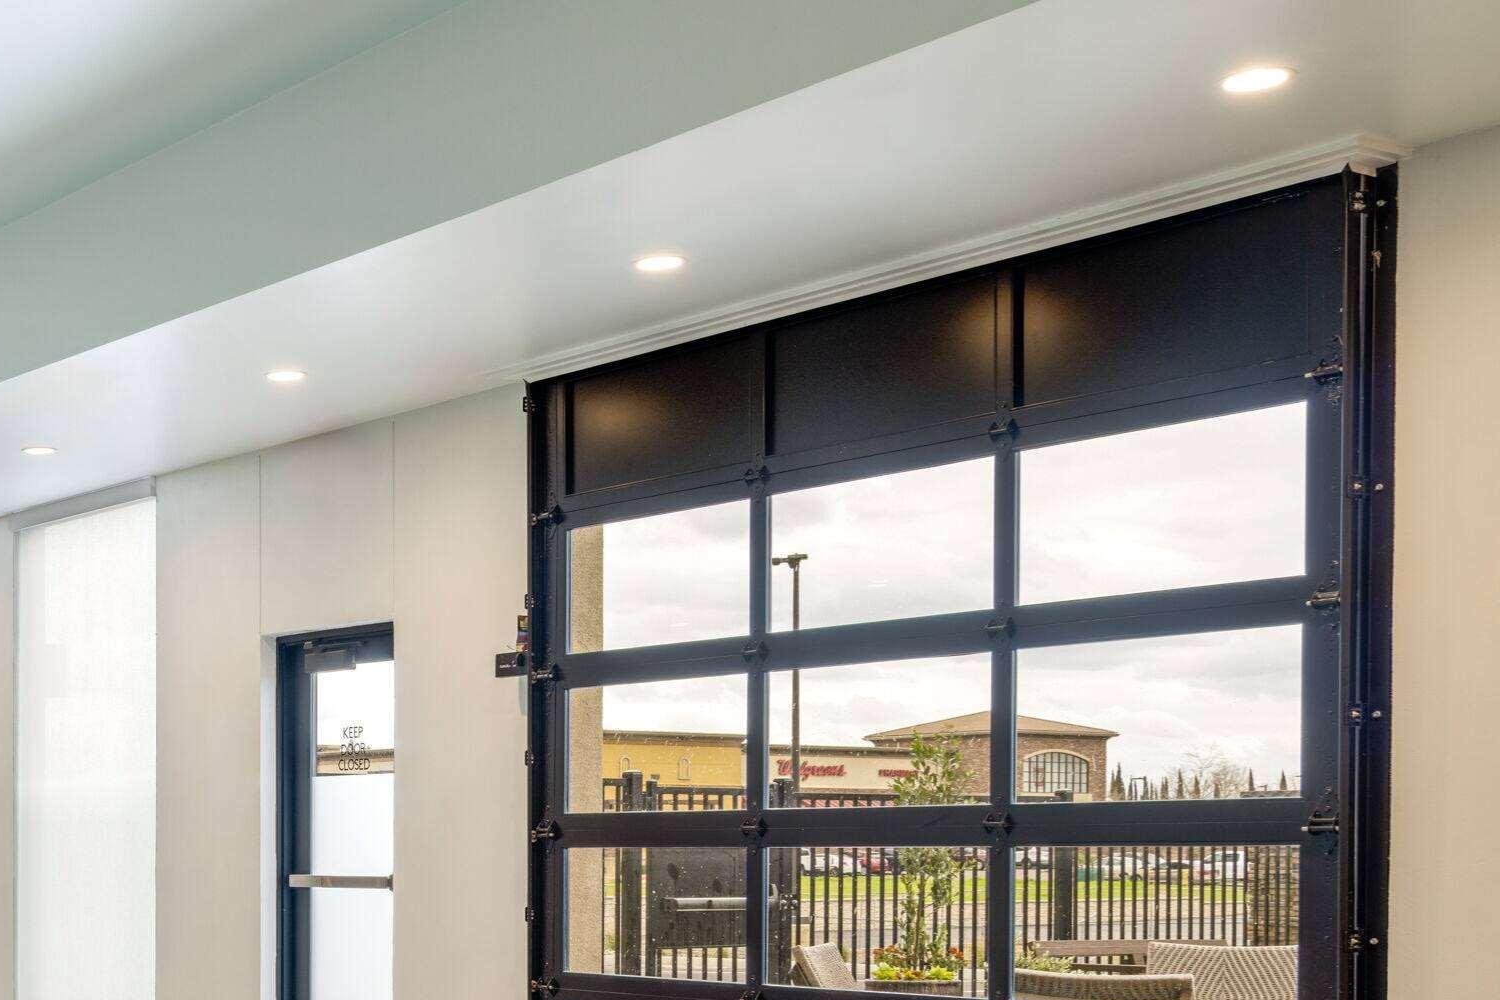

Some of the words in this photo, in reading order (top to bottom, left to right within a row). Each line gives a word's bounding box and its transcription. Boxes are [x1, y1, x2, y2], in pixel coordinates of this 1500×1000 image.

[342, 726, 364, 739] KEEP
[340, 742, 367, 756] DOOR
[338, 758, 371, 771] CLOSED
[776, 760, 847, 781] Wlgreens
